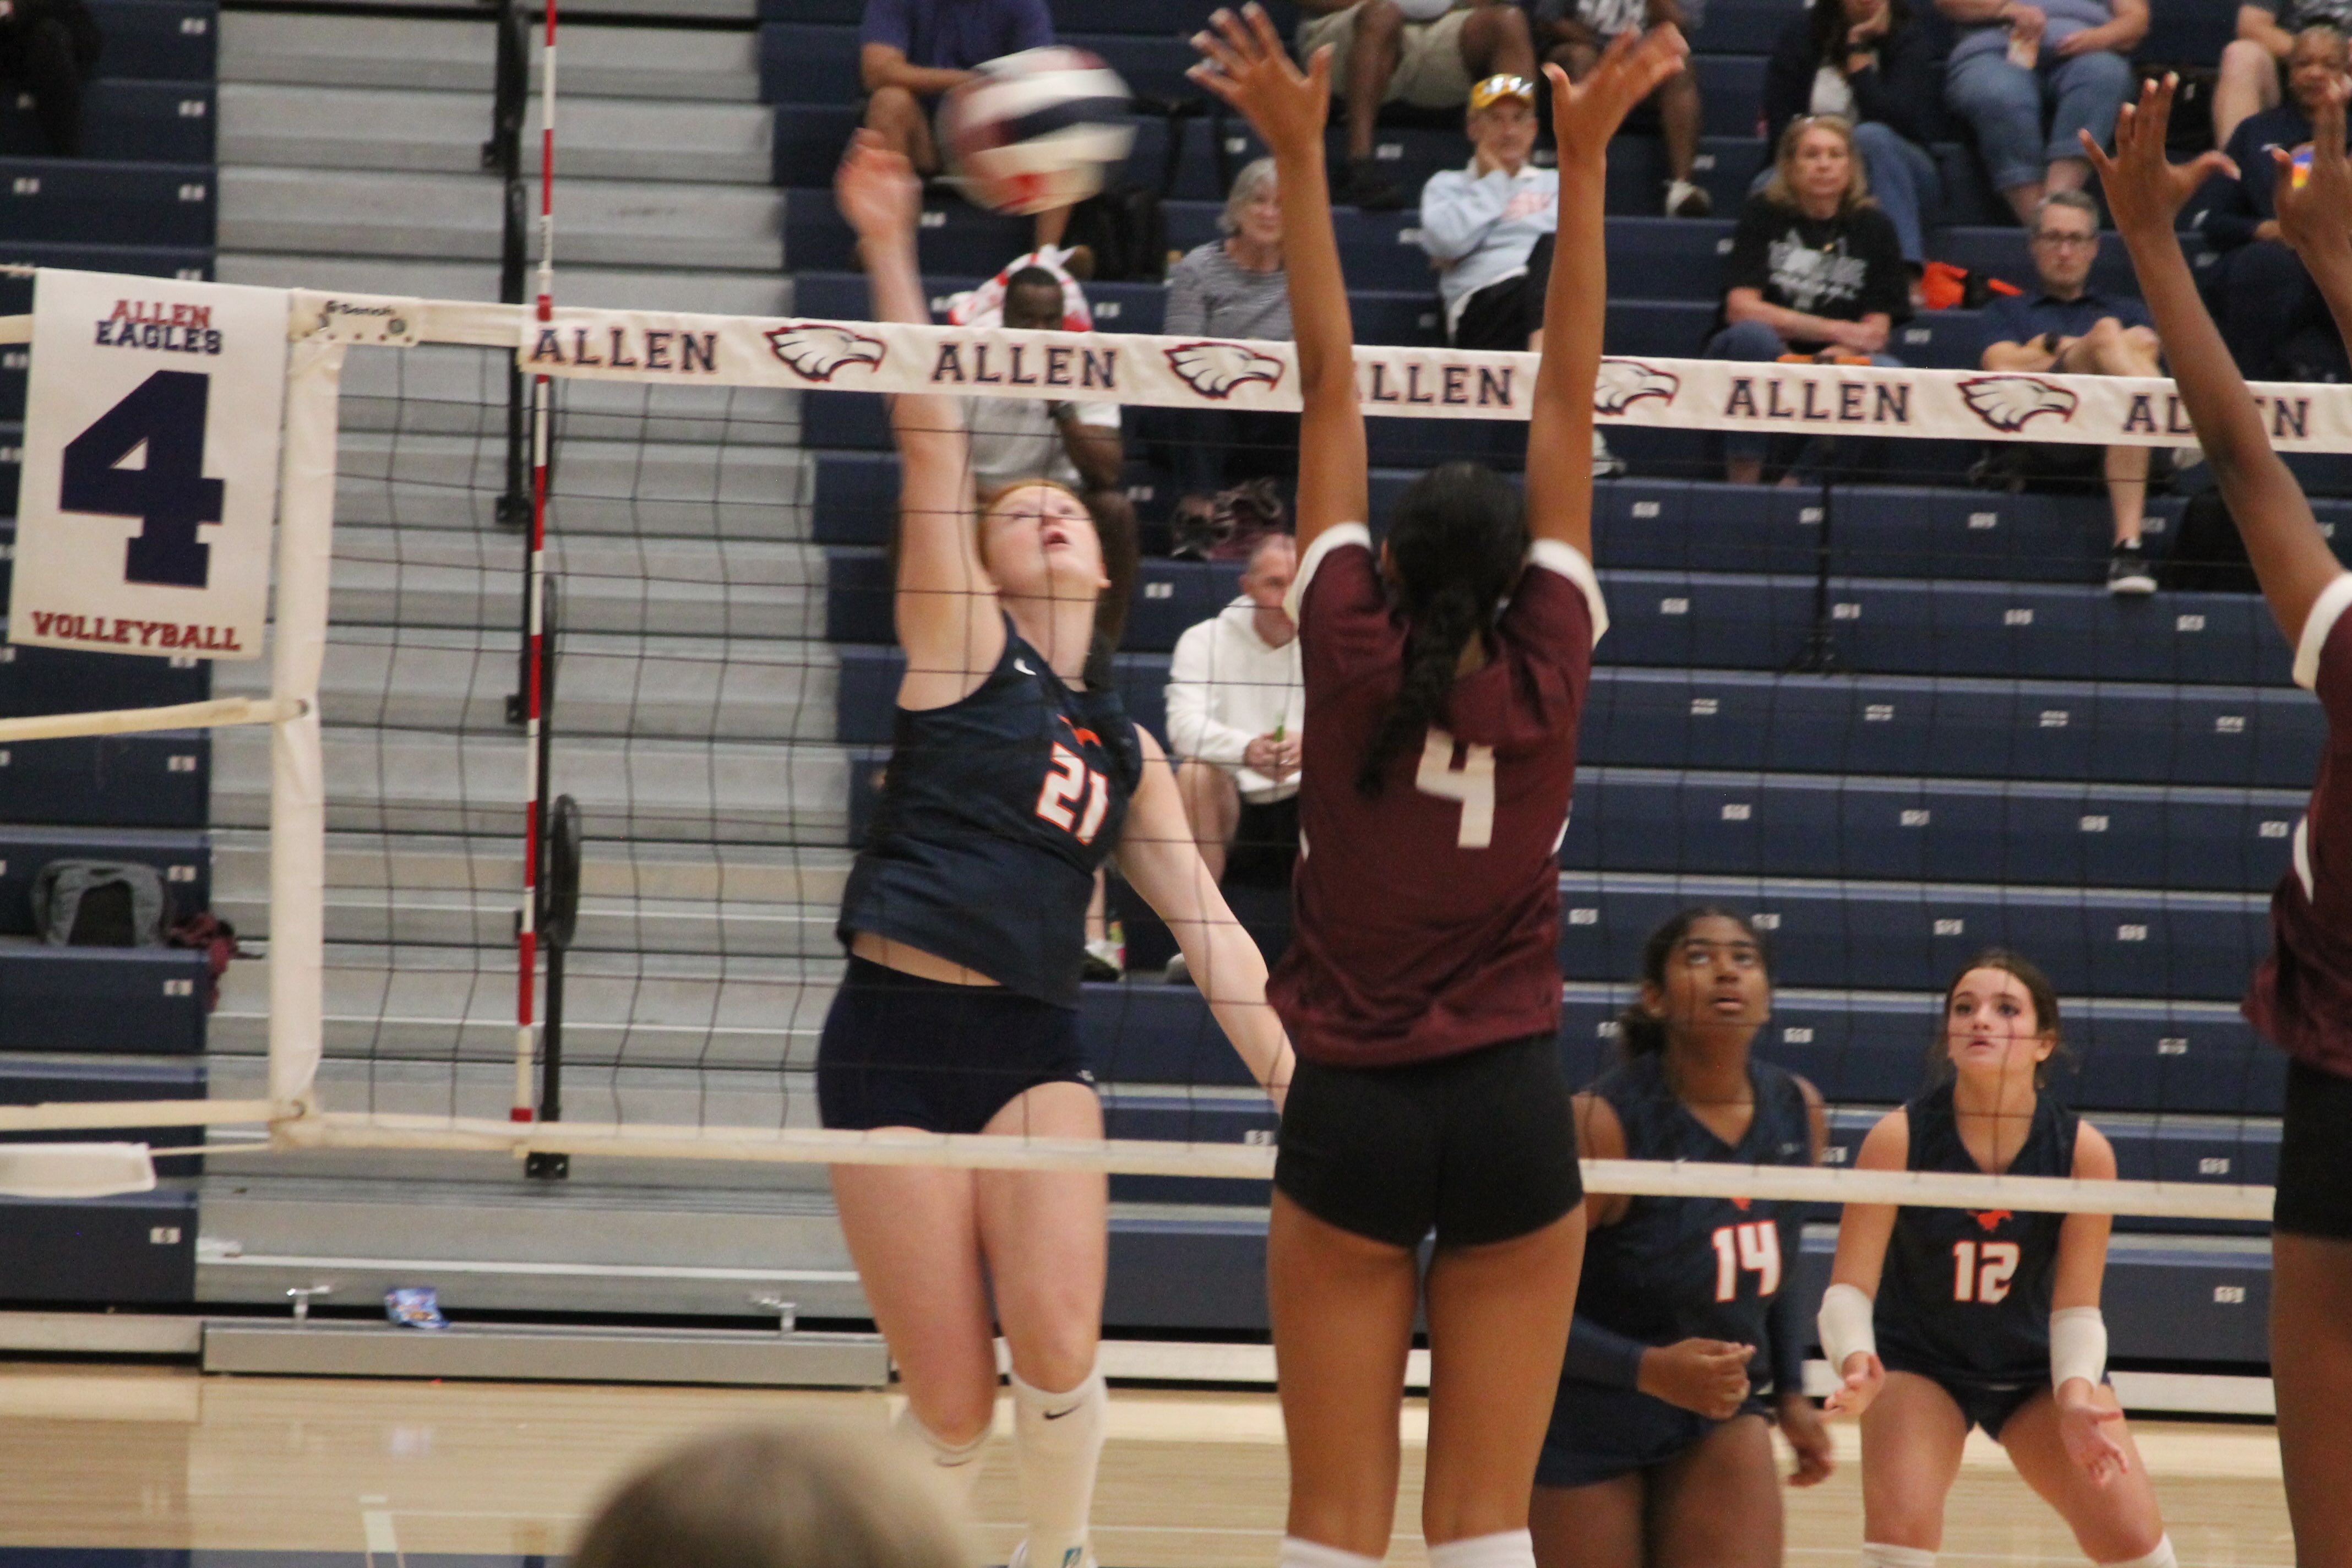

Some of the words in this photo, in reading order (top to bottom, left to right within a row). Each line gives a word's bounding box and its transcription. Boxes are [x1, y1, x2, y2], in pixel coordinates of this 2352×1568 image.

[95, 320, 224, 355] EAGLES
[110, 300, 213, 329] ALLEN
[529, 328, 717, 373] ALLEN
[932, 342, 1119, 390] ALLEN
[1352, 361, 1514, 409] LLEN
[1724, 376, 1910, 425] ALLEN
[2122, 393, 2311, 438] ALN
[58, 369, 225, 590] 4
[31, 611, 241, 651] VOLLEYBALL
[1036, 741, 1109, 846] 21
[1415, 727, 1496, 848] 4
[1712, 1219, 1782, 1303] 14
[1952, 1240, 2020, 1304] 12
